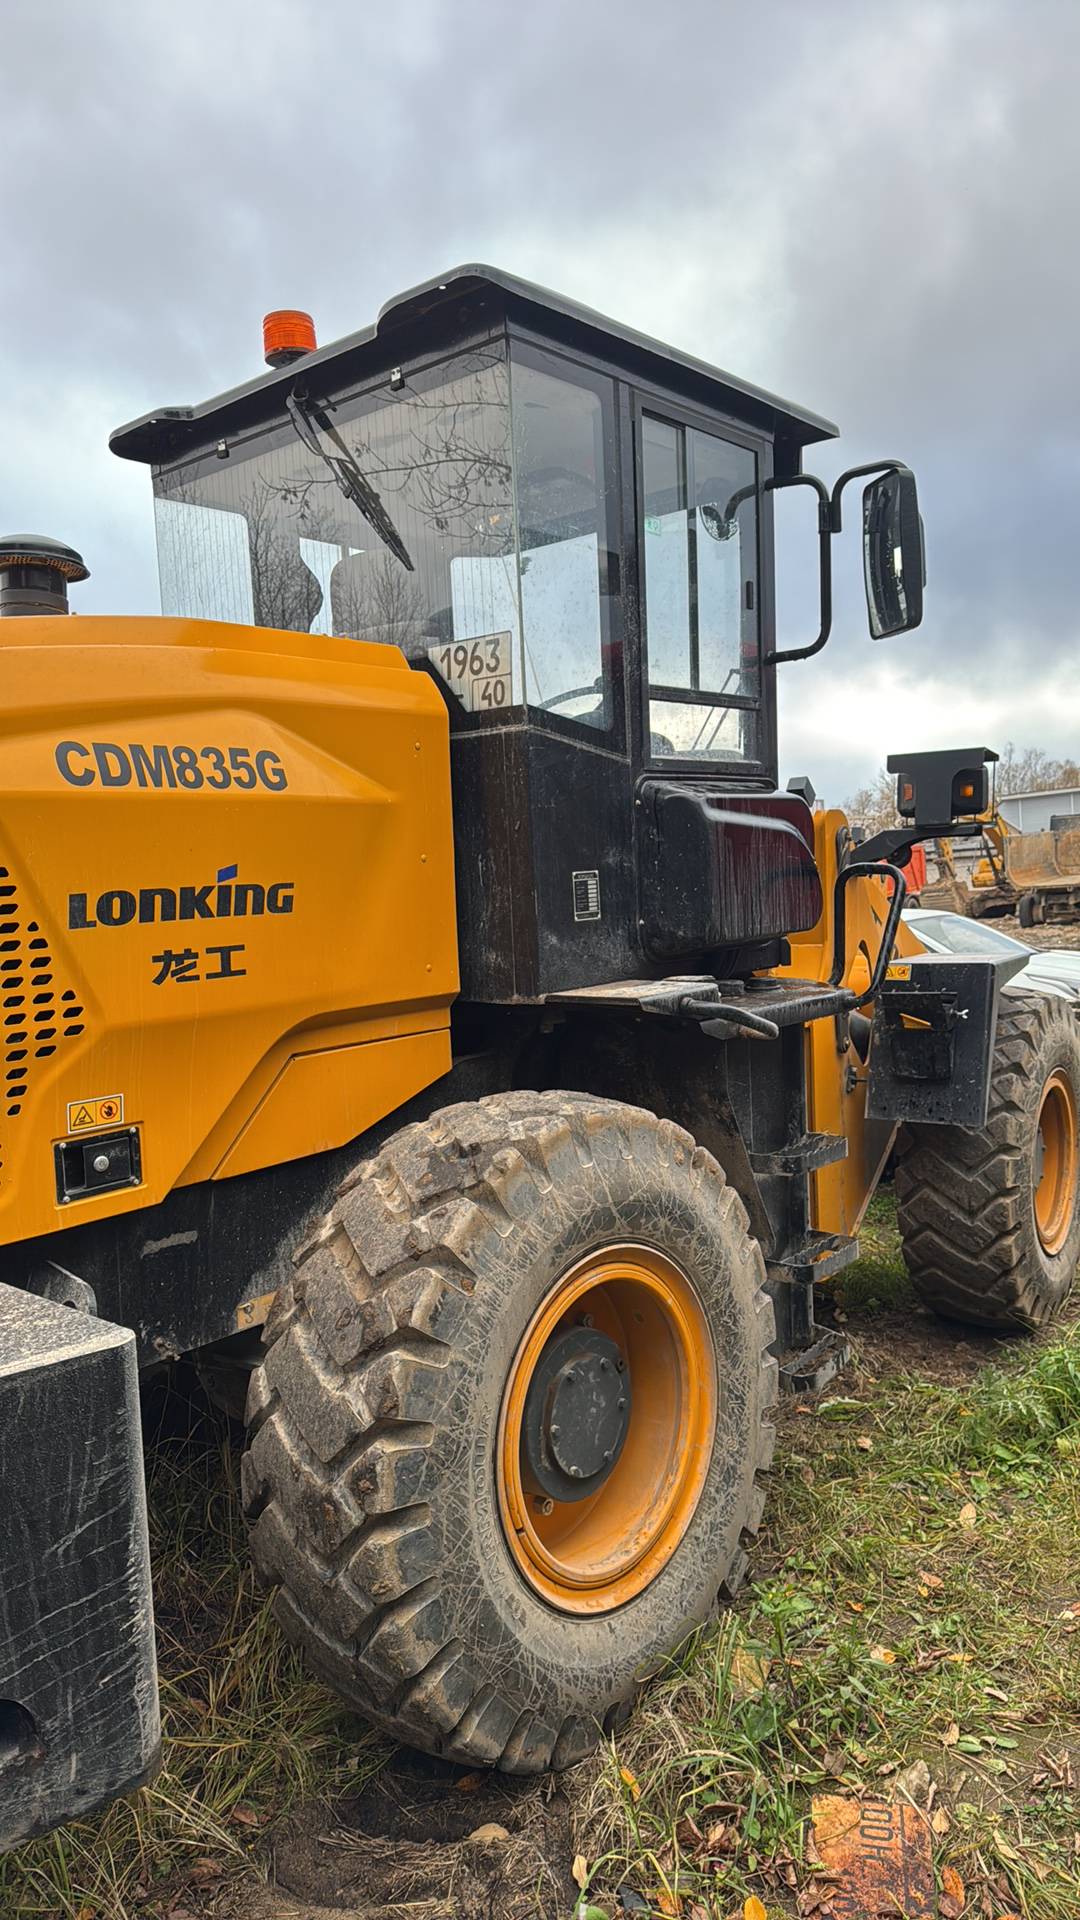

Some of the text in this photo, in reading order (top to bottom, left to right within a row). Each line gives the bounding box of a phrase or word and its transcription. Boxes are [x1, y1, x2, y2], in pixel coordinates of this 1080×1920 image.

[440, 638, 501, 680] 1963
[481, 679, 505, 707] 40
[55, 740, 289, 792] CDM835G
[151, 943, 247, 986] 龙工
